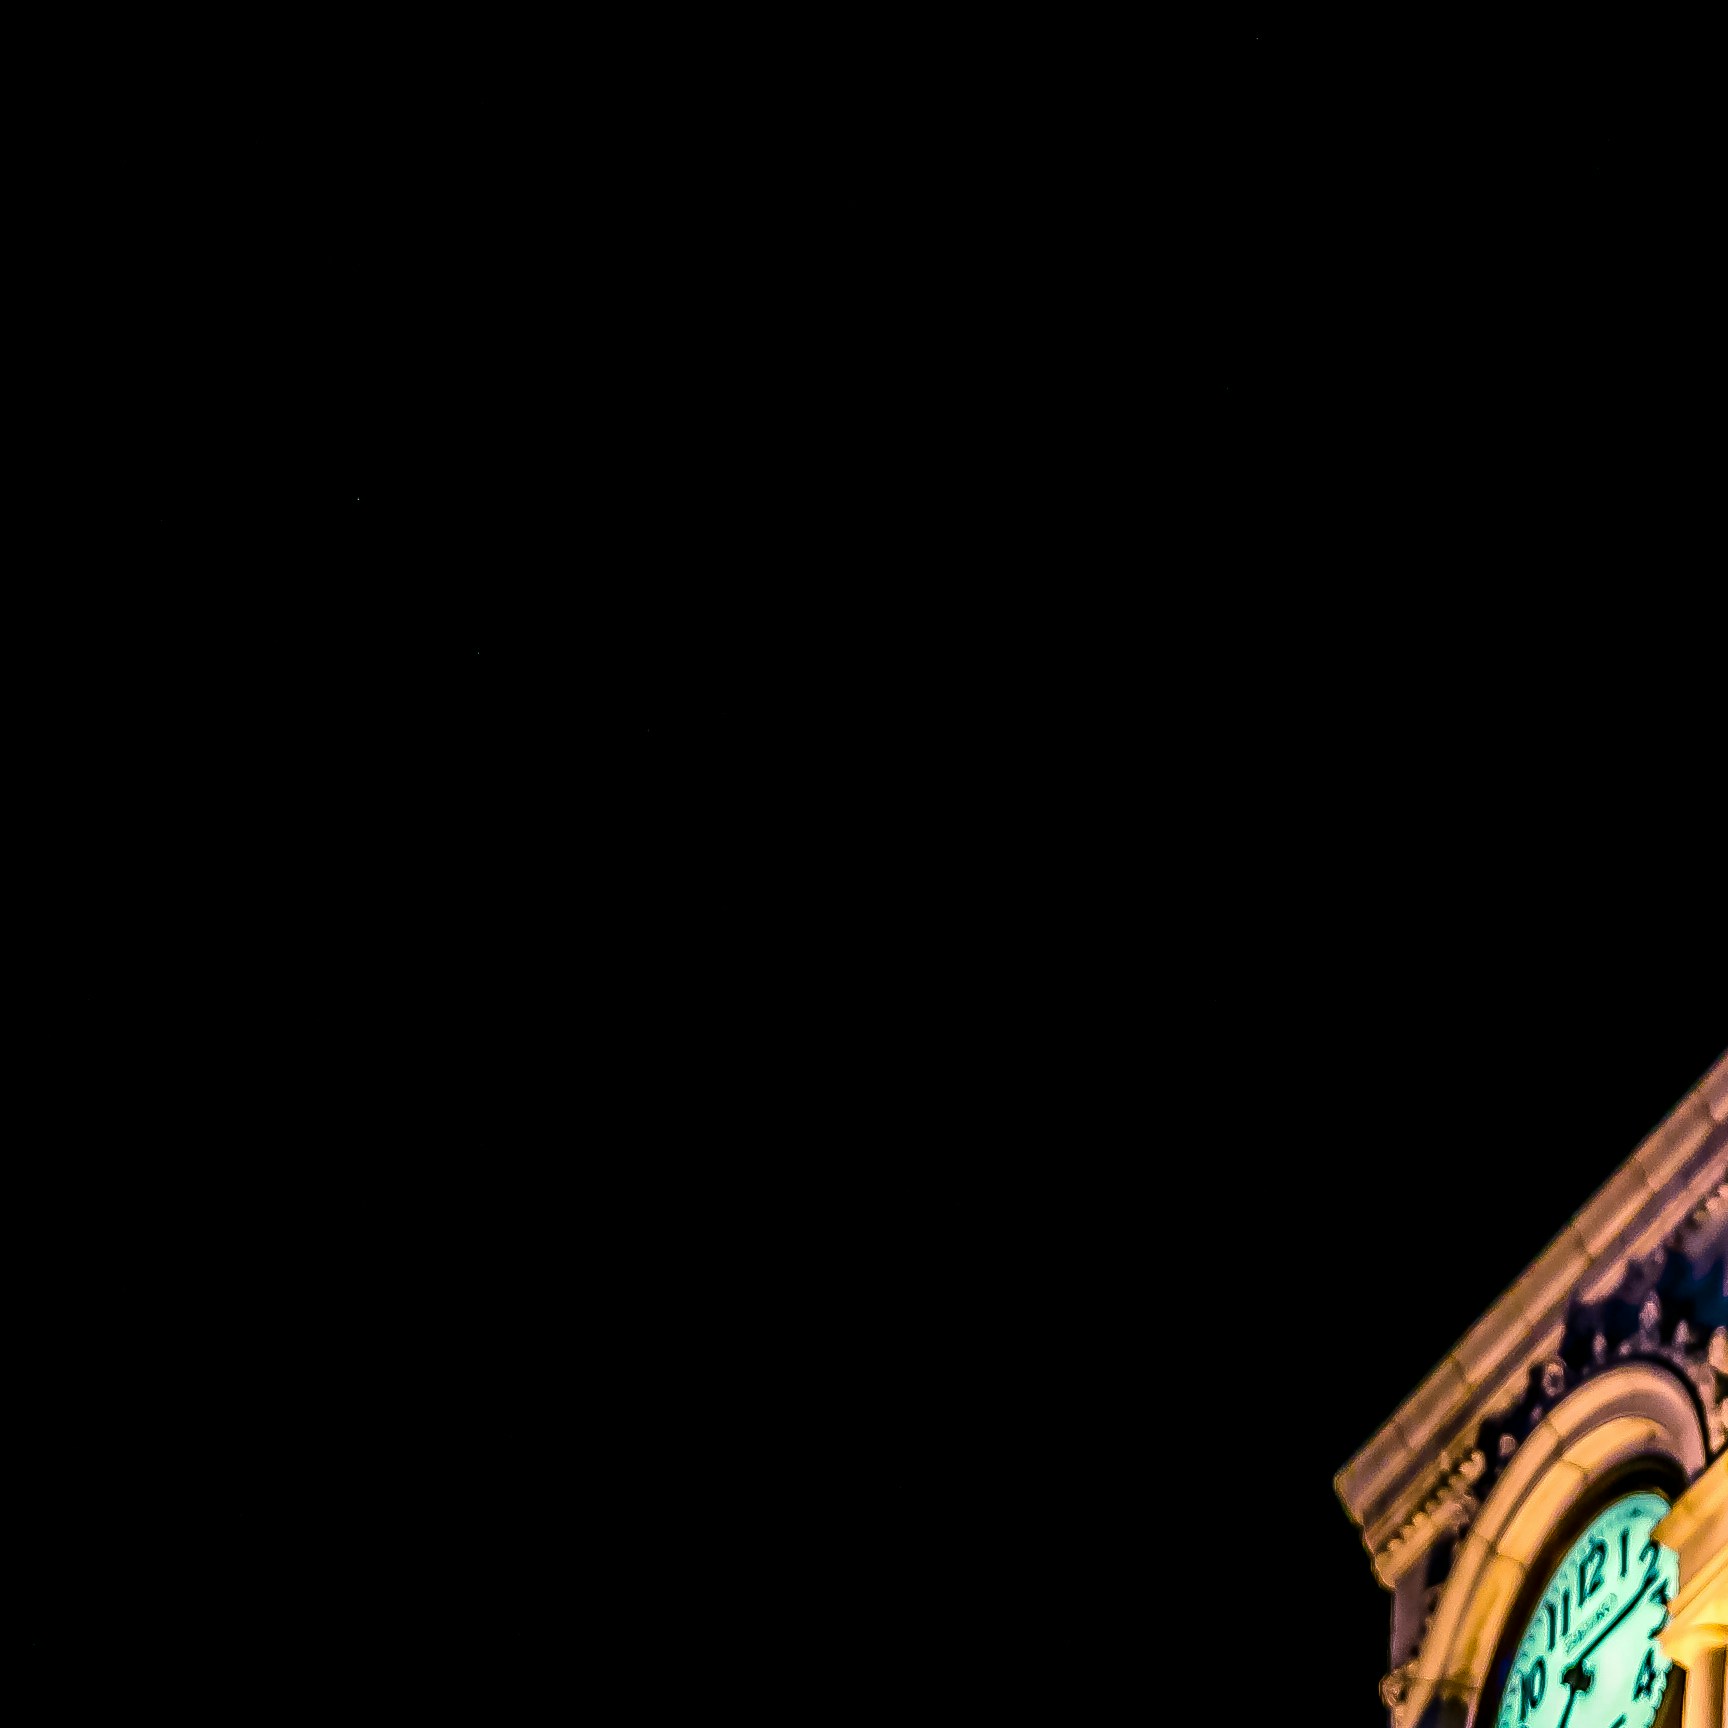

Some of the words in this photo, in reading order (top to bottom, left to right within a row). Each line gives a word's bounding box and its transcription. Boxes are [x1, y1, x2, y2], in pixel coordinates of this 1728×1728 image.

[1578, 1538, 1608, 1607] 12
[1619, 1527, 1629, 1577] 1
[1546, 1587, 1570, 1652] 11
[1519, 1655, 1546, 1722] 10
